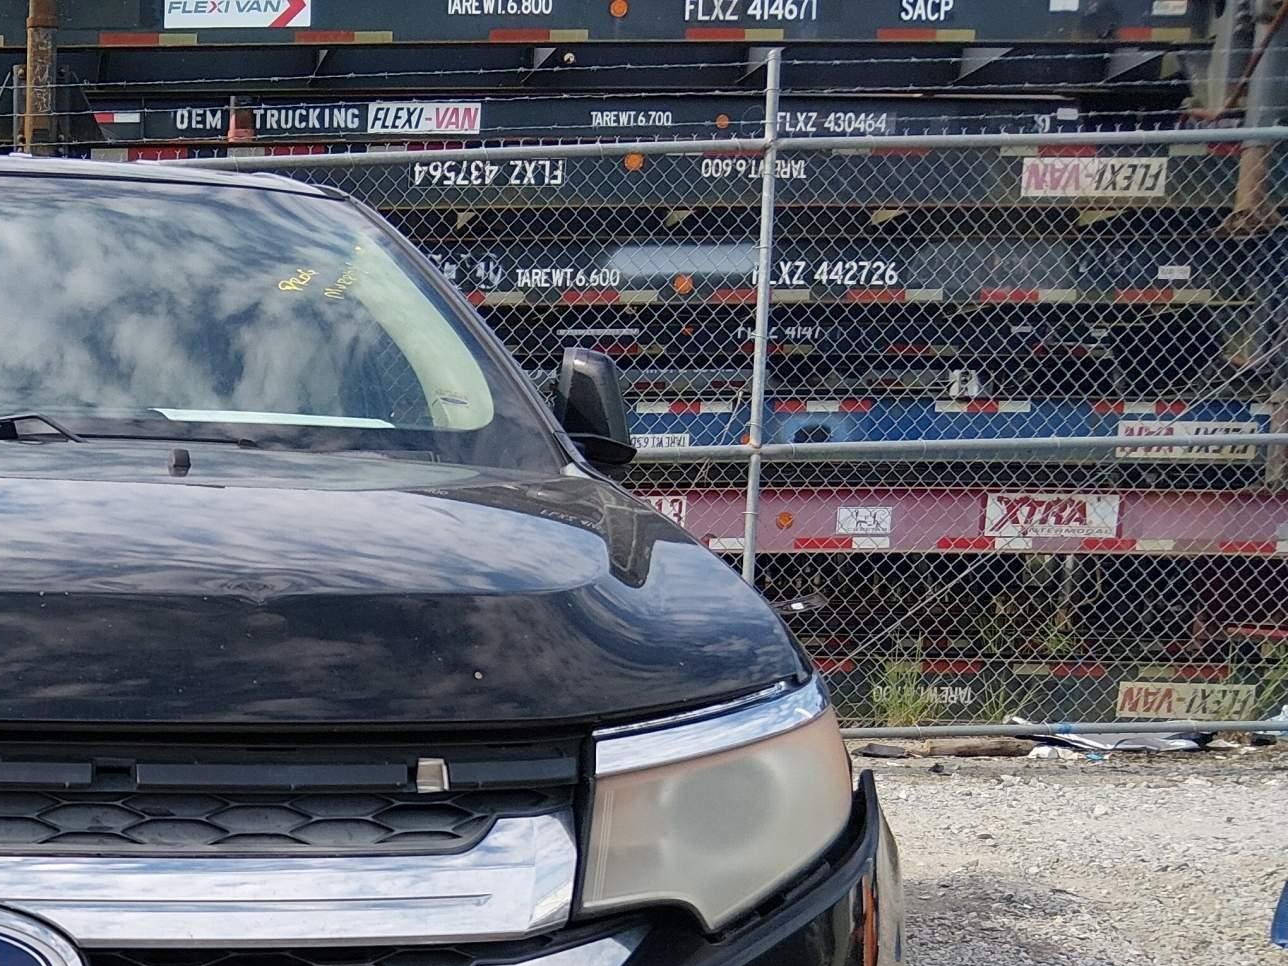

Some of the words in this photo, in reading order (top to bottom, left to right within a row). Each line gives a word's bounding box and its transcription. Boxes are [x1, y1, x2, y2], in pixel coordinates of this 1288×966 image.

[167, 0, 231, 14] FLEXI
[234, 0, 281, 13] VAN
[684, 0, 739, 20] FLXZ
[900, 0, 953, 20] SACP
[175, 108, 223, 130] OEM
[253, 107, 360, 130] TRUCKING
[370, 106, 480, 132] FLEXI-VAN
[776, 112, 818, 132] FLXZ
[823, 112, 888, 132] 430464
[413, 160, 499, 185] 437564
[510, 160, 563, 185] FLXZ
[1024, 163, 1164, 192] FLEXI-VAN
[813, 261, 899, 285] 442726
[990, 495, 1088, 532] XTRA
